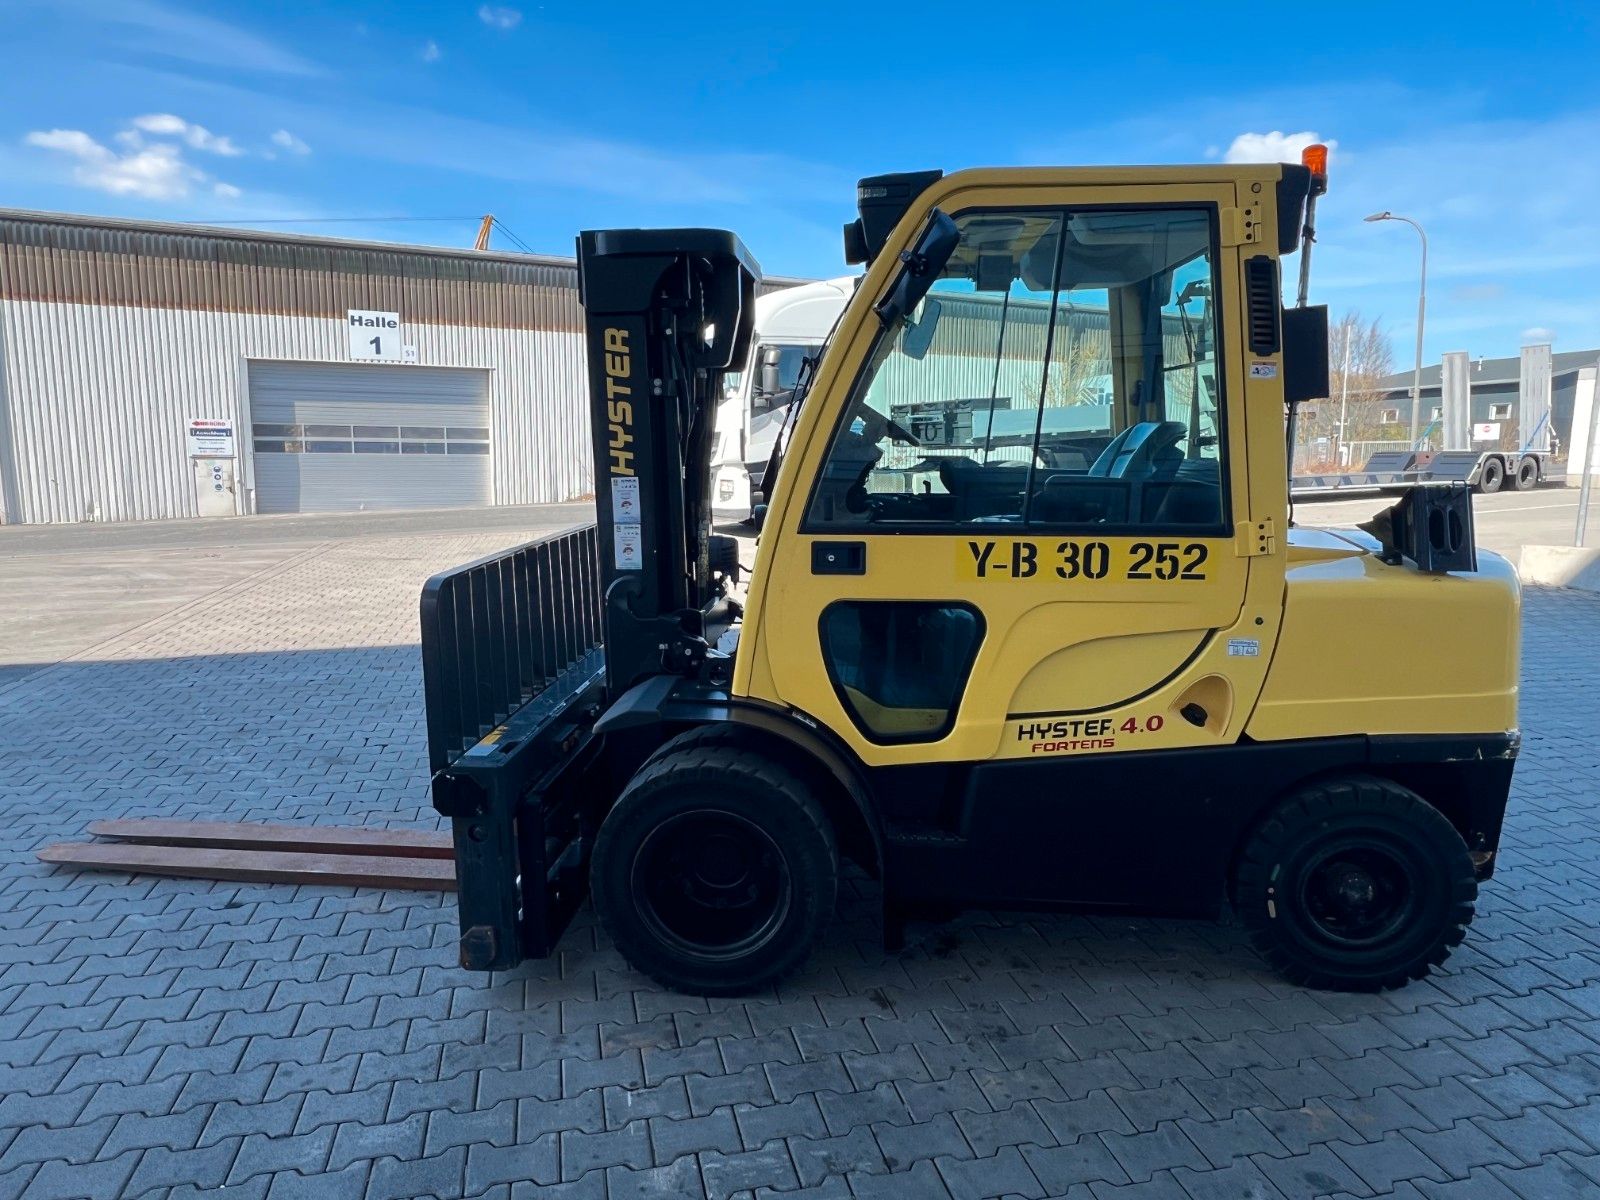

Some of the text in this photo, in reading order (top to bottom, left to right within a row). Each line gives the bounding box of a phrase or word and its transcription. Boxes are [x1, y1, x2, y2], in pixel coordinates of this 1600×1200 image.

[350, 315, 397, 328] Halle
[369, 336, 381, 355] 1
[604, 326, 635, 476] HYSTER
[968, 541, 1208, 580] Y-B 30 252
[1120, 715, 1164, 734] 4.0
[1031, 738, 1115, 753] FORTENS
